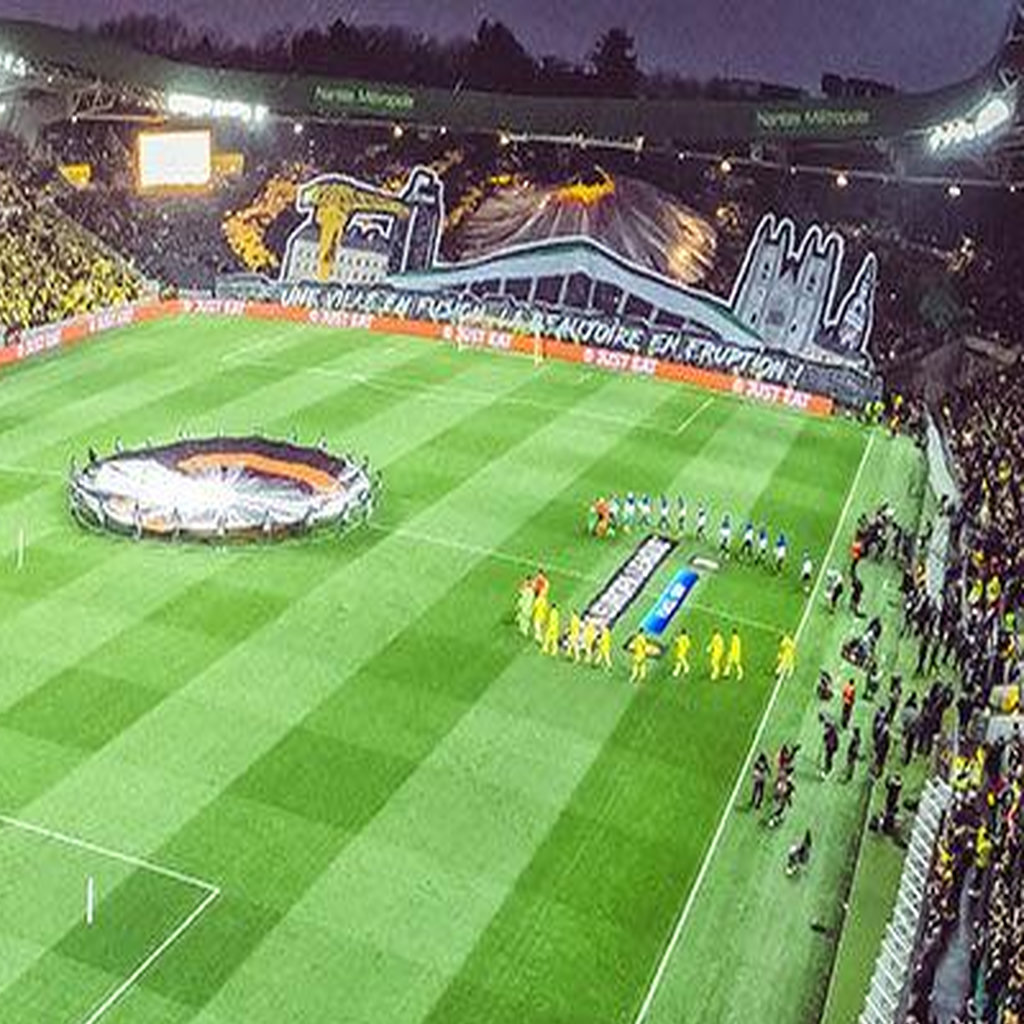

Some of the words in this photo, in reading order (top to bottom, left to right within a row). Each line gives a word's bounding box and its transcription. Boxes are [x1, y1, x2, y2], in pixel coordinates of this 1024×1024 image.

[281, 284, 321, 308] UNE
[648, 330, 681, 356] EN
[595, 347, 631, 372] JUST
[631, 353, 658, 375] EAT
[743, 377, 780, 402] JUST
